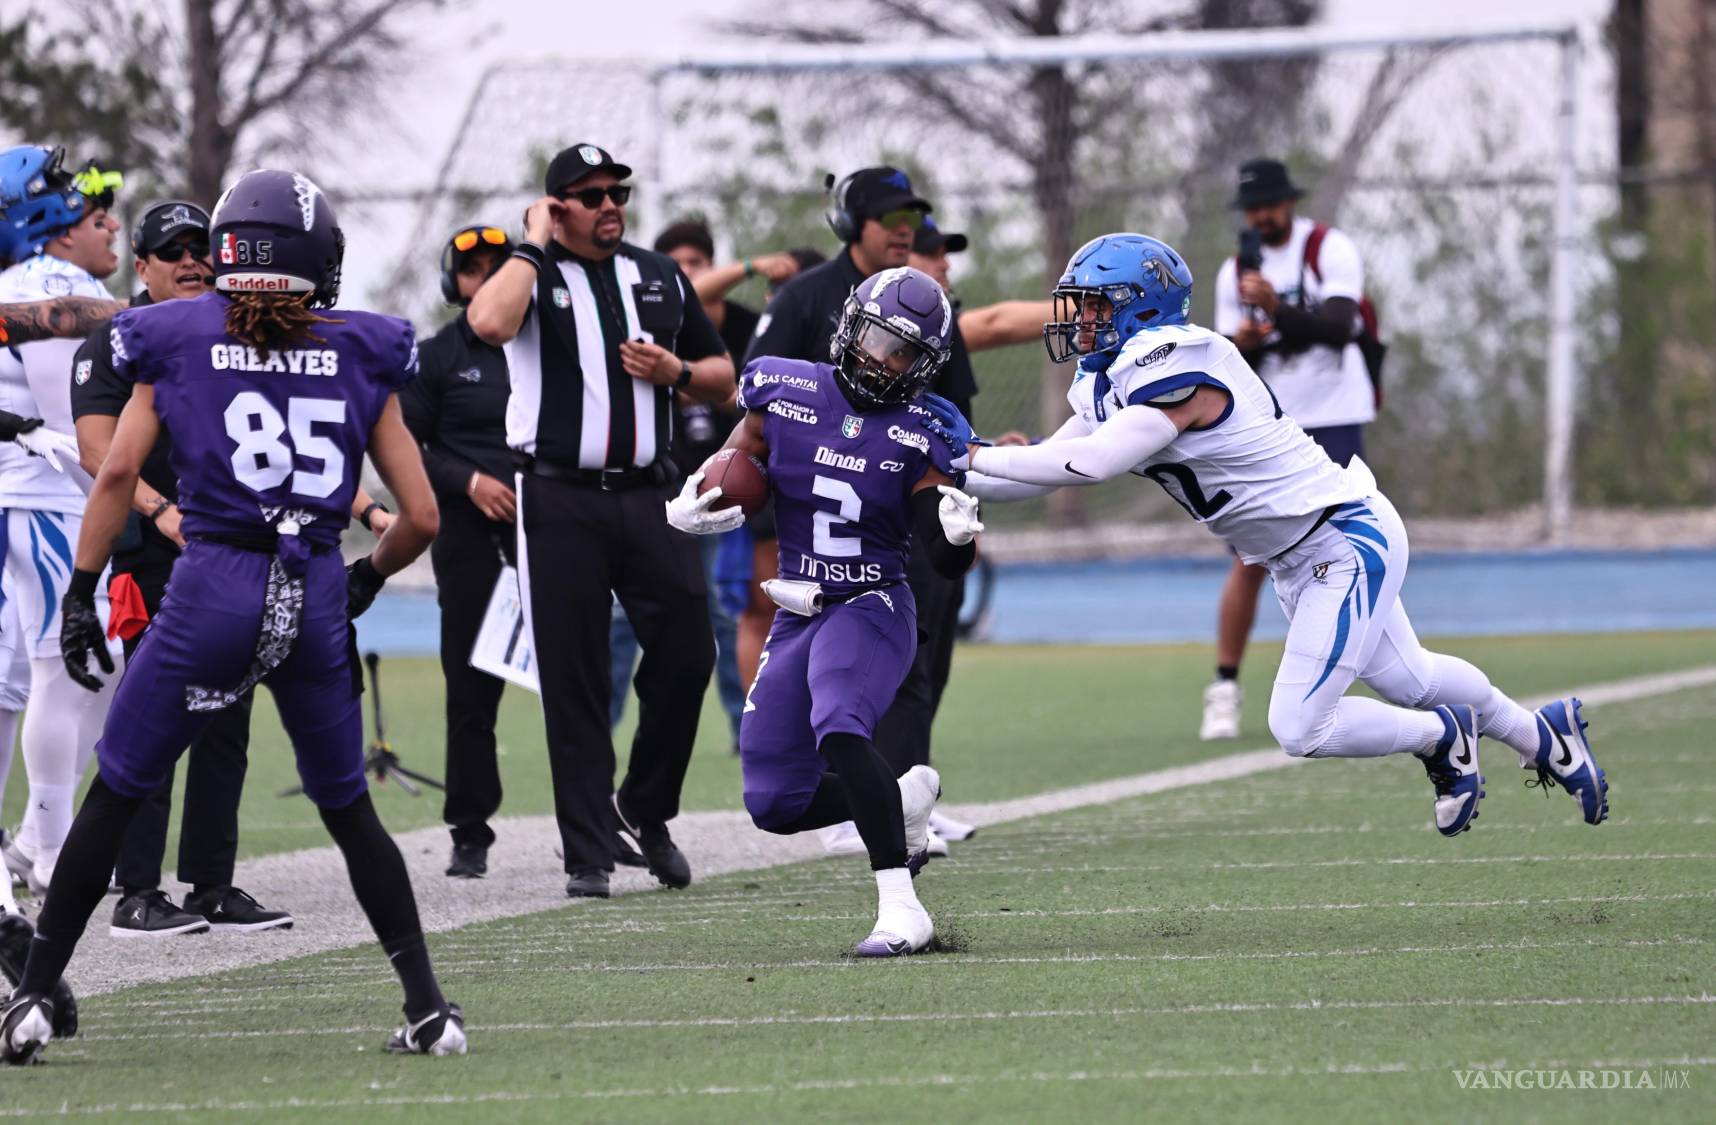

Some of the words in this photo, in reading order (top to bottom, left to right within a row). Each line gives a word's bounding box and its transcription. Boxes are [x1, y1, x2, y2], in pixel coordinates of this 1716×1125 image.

[236, 240, 273, 264] 85
[227, 278, 289, 290] Riddell
[211, 344, 338, 376] GREAVES
[761, 374, 780, 384] GAS
[782, 375, 818, 390] CAPITAL
[781, 400, 793, 409] POR
[224, 391, 346, 498] 85
[814, 446, 867, 472] Dinos
[812, 474, 862, 557] 2
